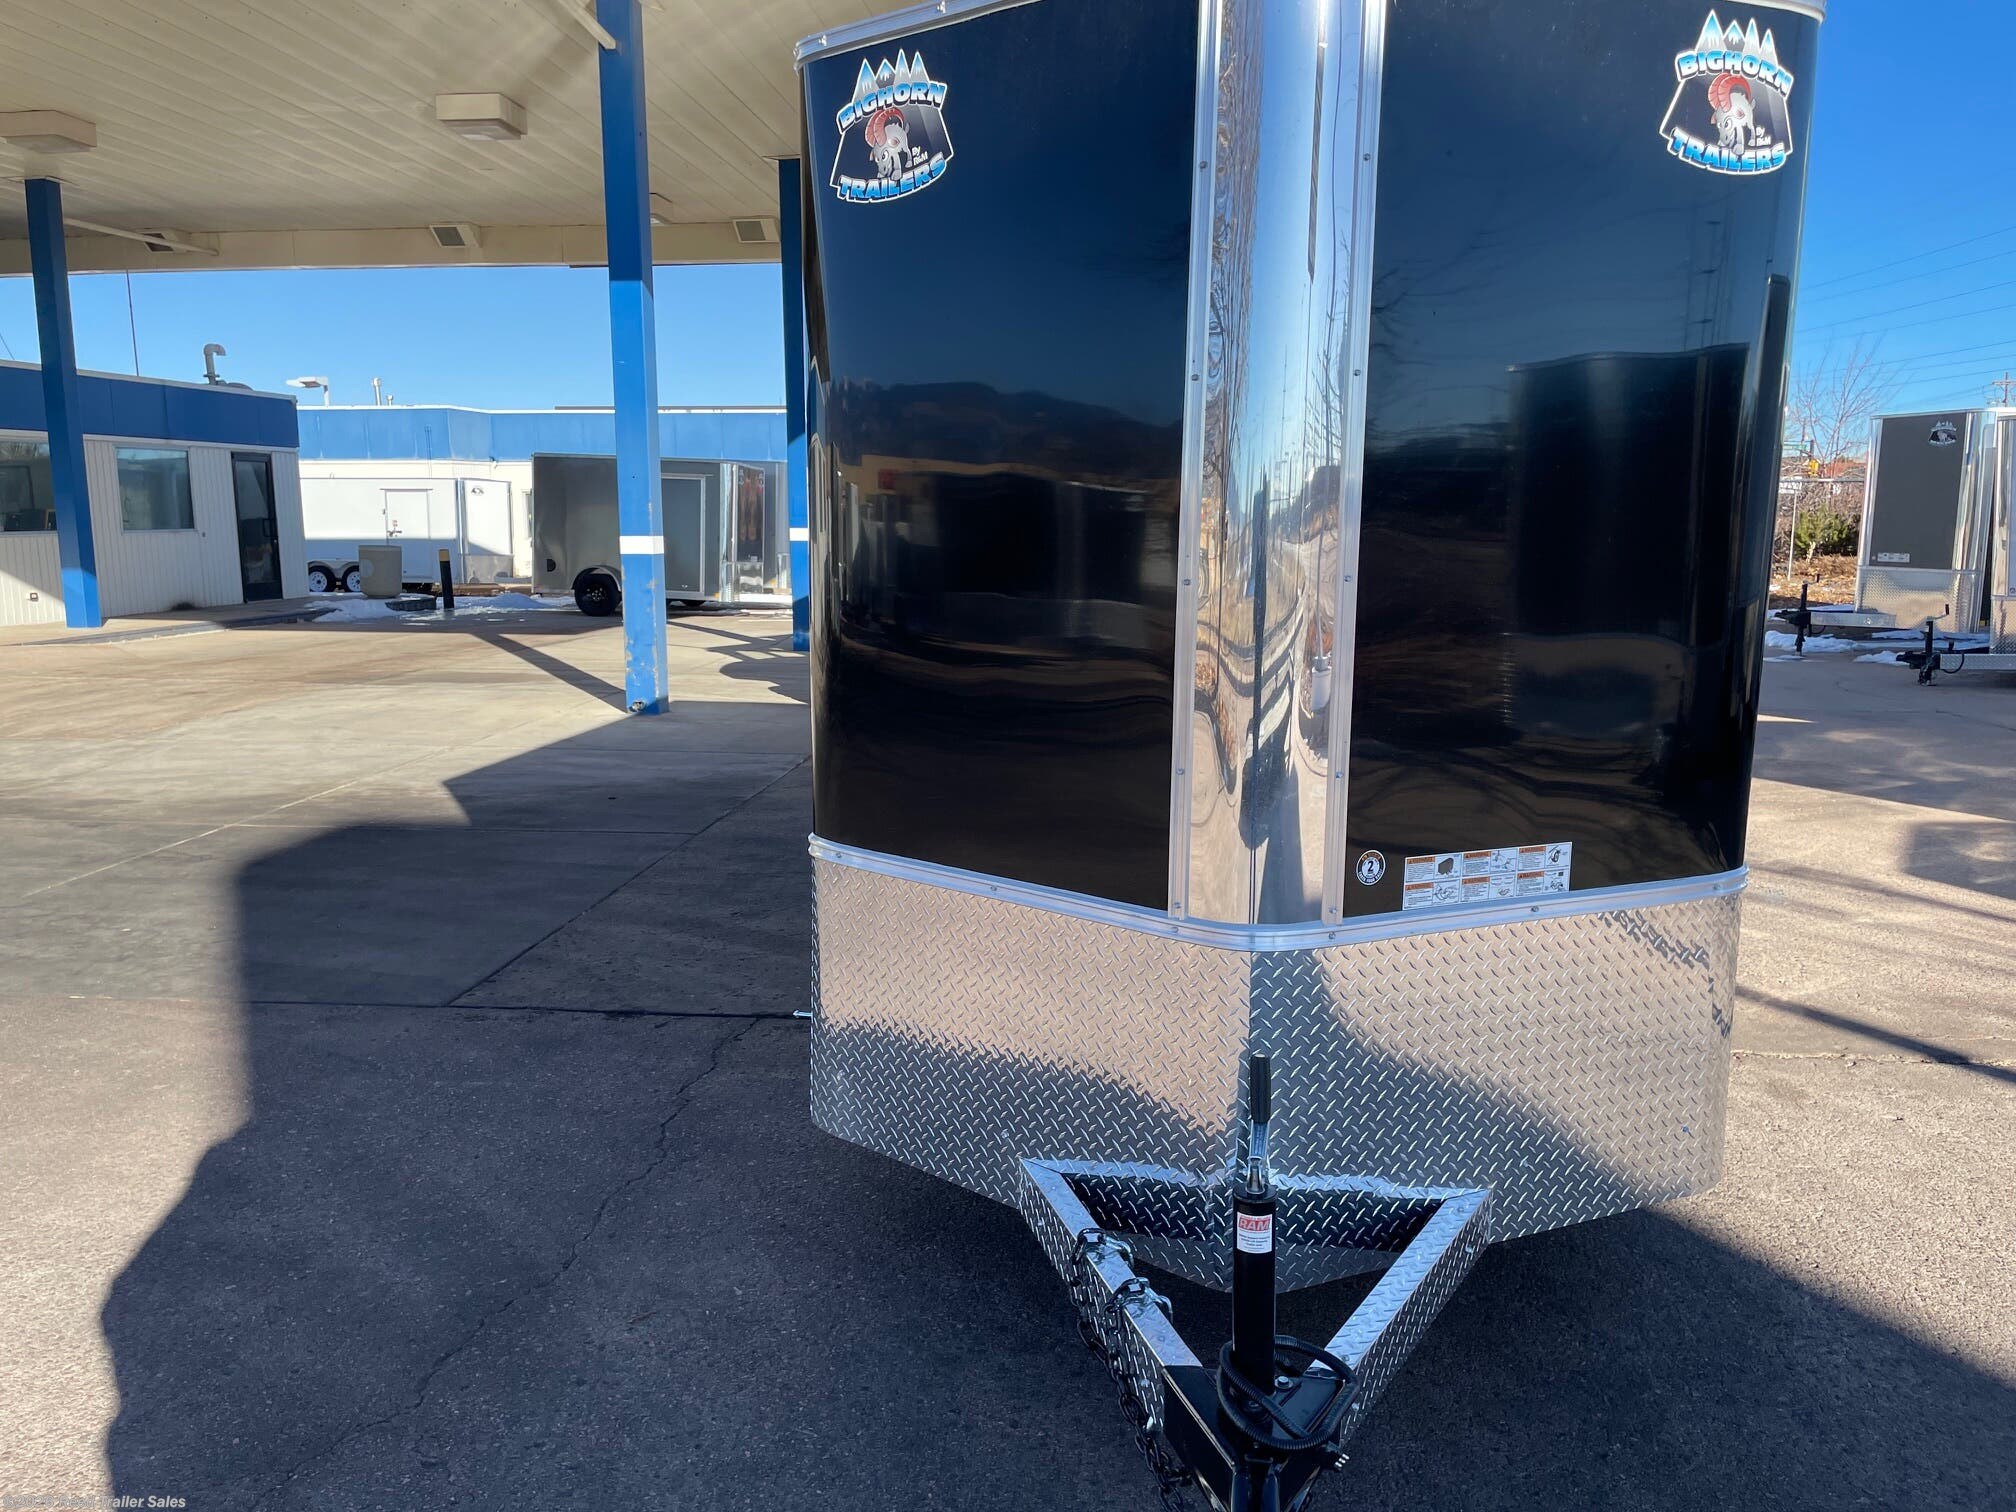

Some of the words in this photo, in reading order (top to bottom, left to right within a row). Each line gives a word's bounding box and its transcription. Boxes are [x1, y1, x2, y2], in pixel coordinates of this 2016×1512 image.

[1677, 50, 1794, 96] BIGHORN
[838, 81, 946, 129] BIGHORN
[1671, 127, 1786, 172] TRAILERS
[839, 152, 946, 200] TRAILERS
[1367, 860, 1374, 872] 2
[1239, 1218, 1270, 1231] RAM
